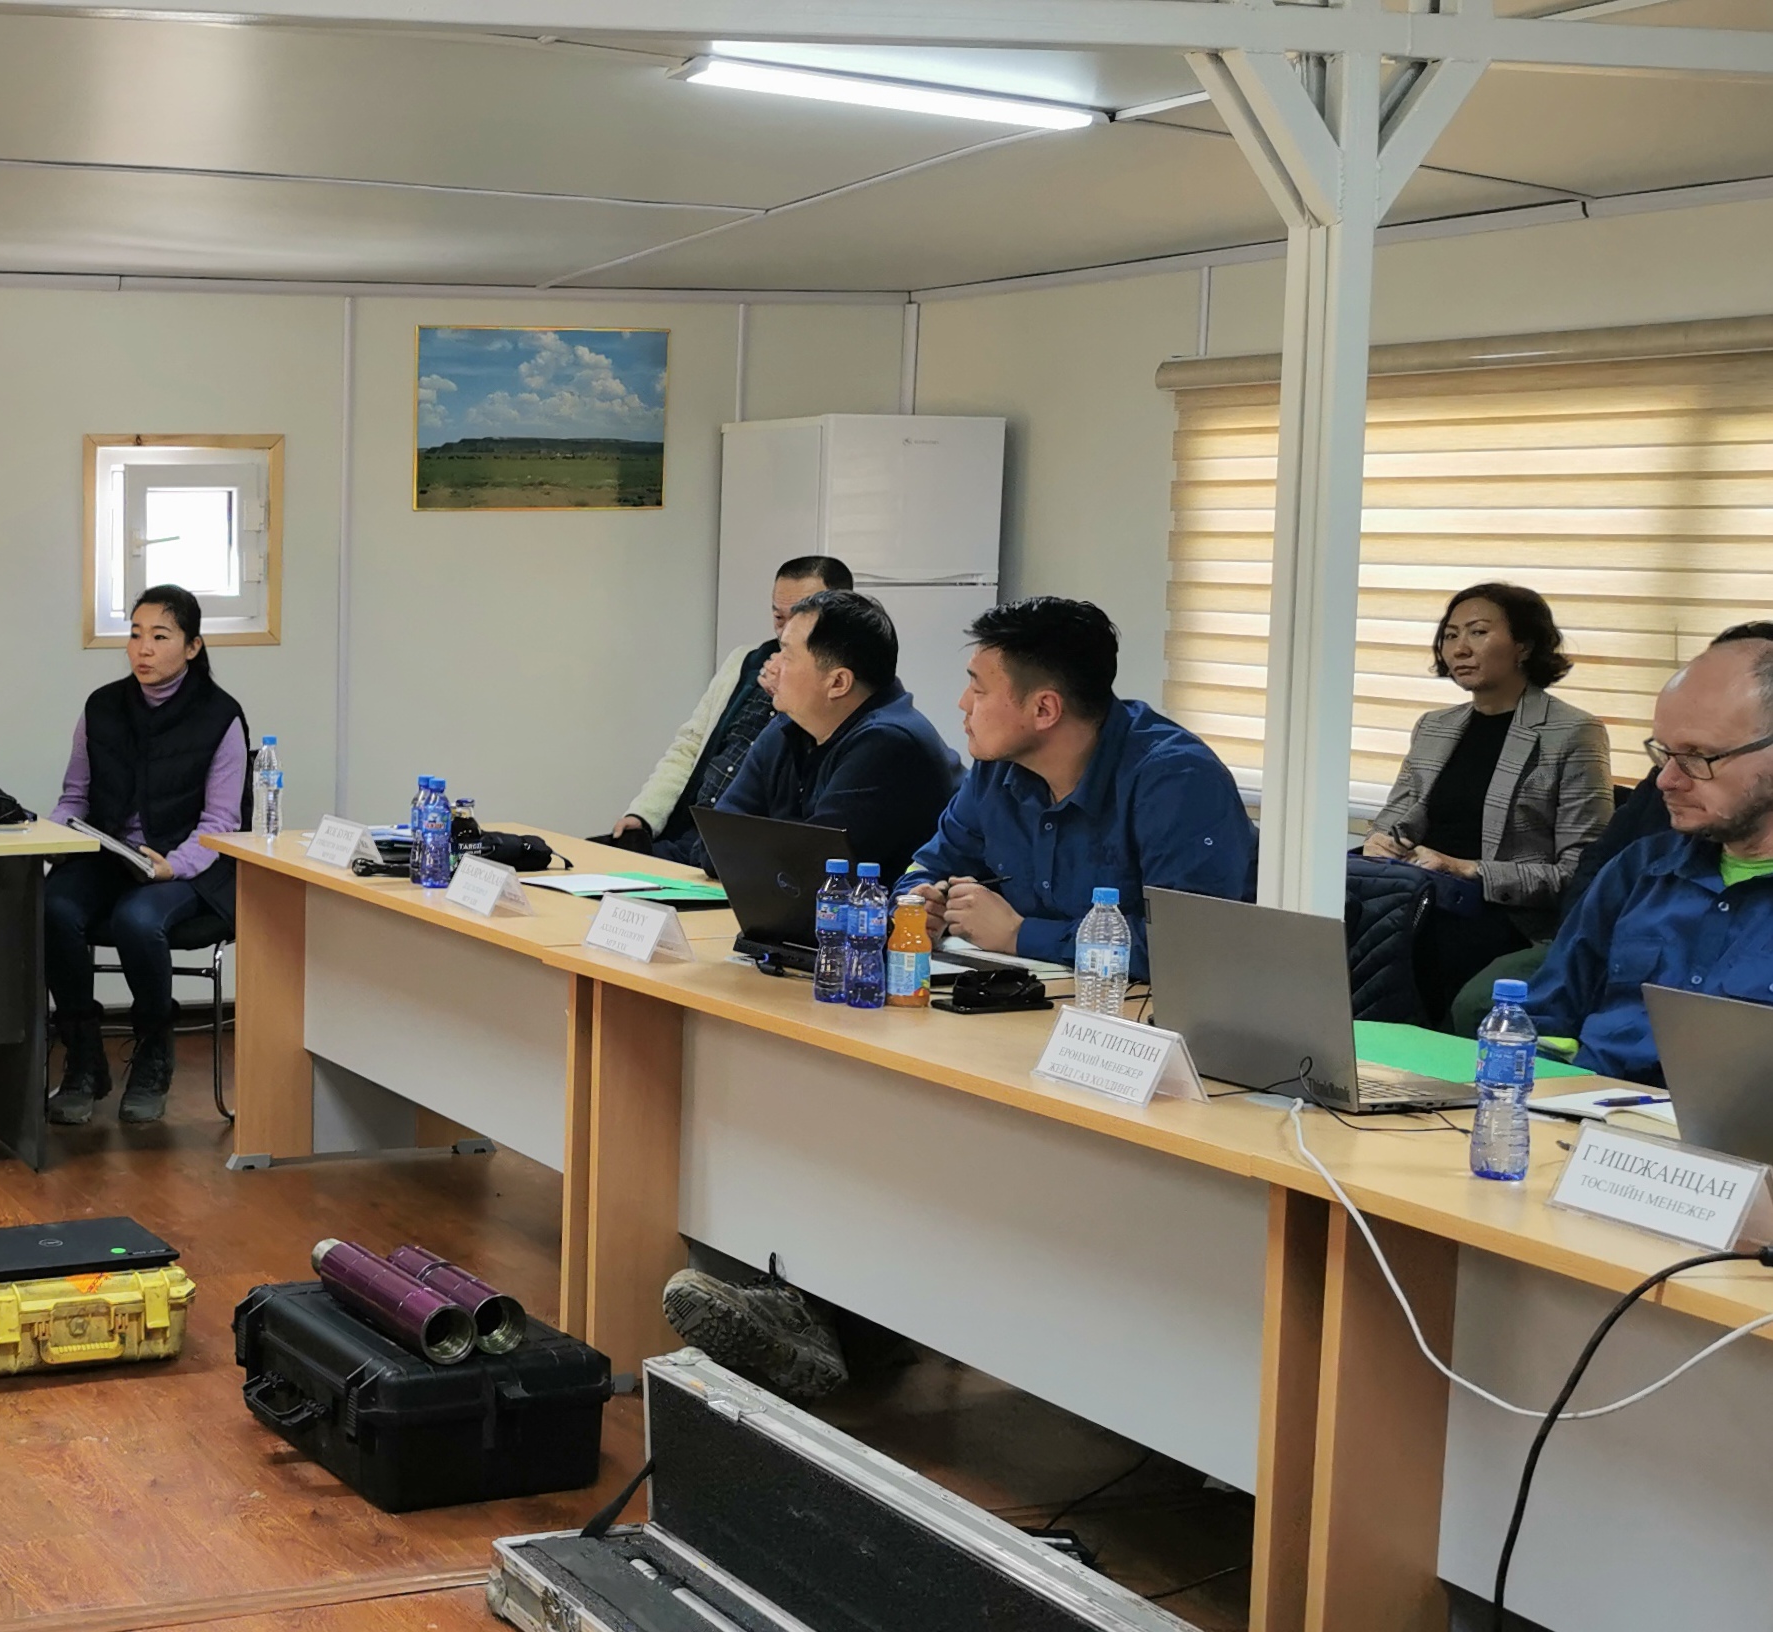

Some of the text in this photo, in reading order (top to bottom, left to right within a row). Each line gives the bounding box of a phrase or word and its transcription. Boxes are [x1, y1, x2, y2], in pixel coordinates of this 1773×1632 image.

[1060, 1022, 1162, 1063] МАРК ПИТКИН
[1099, 1058, 1144, 1080] МЕНЕЖЕР
[1582, 1144, 1739, 1200] Г.ИШЖАНЦАН
[1580, 1174, 1717, 1222] ТӨСЛИЙН МЕНЕЖЕР
